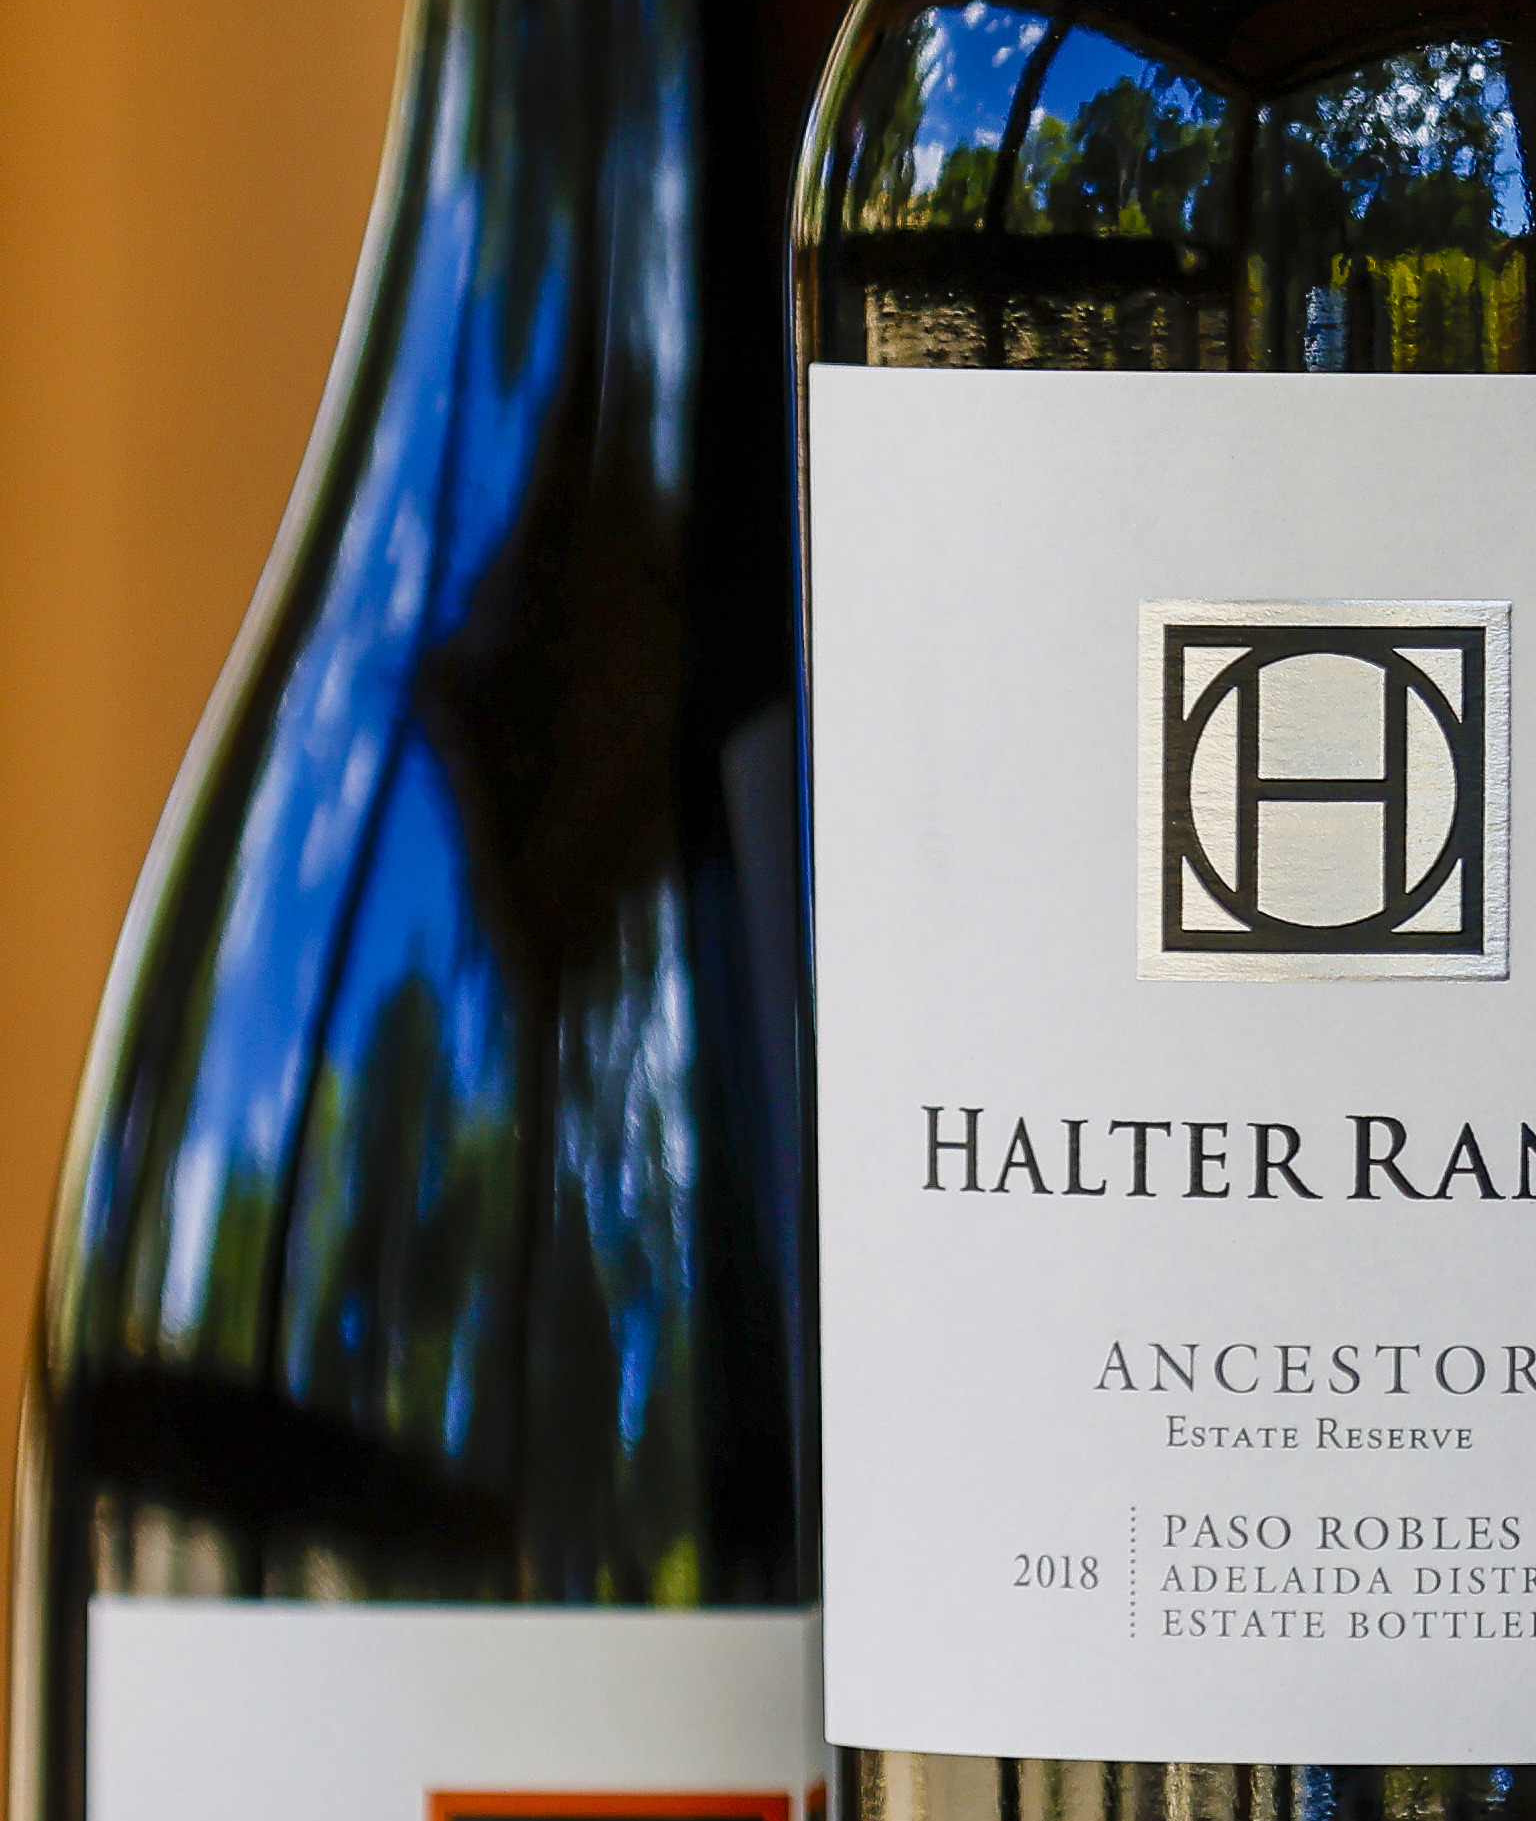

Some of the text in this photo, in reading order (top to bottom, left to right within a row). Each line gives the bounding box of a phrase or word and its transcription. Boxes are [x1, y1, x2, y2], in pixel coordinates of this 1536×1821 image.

[921, 1104, 1324, 1201] HALTER
[1162, 1512, 1522, 1552] PASO ROBLES
[1012, 1552, 1100, 1591] 2018
[1160, 1563, 1393, 1595] ADELAIDA
[1161, 1607, 1326, 1640] ESTATE
